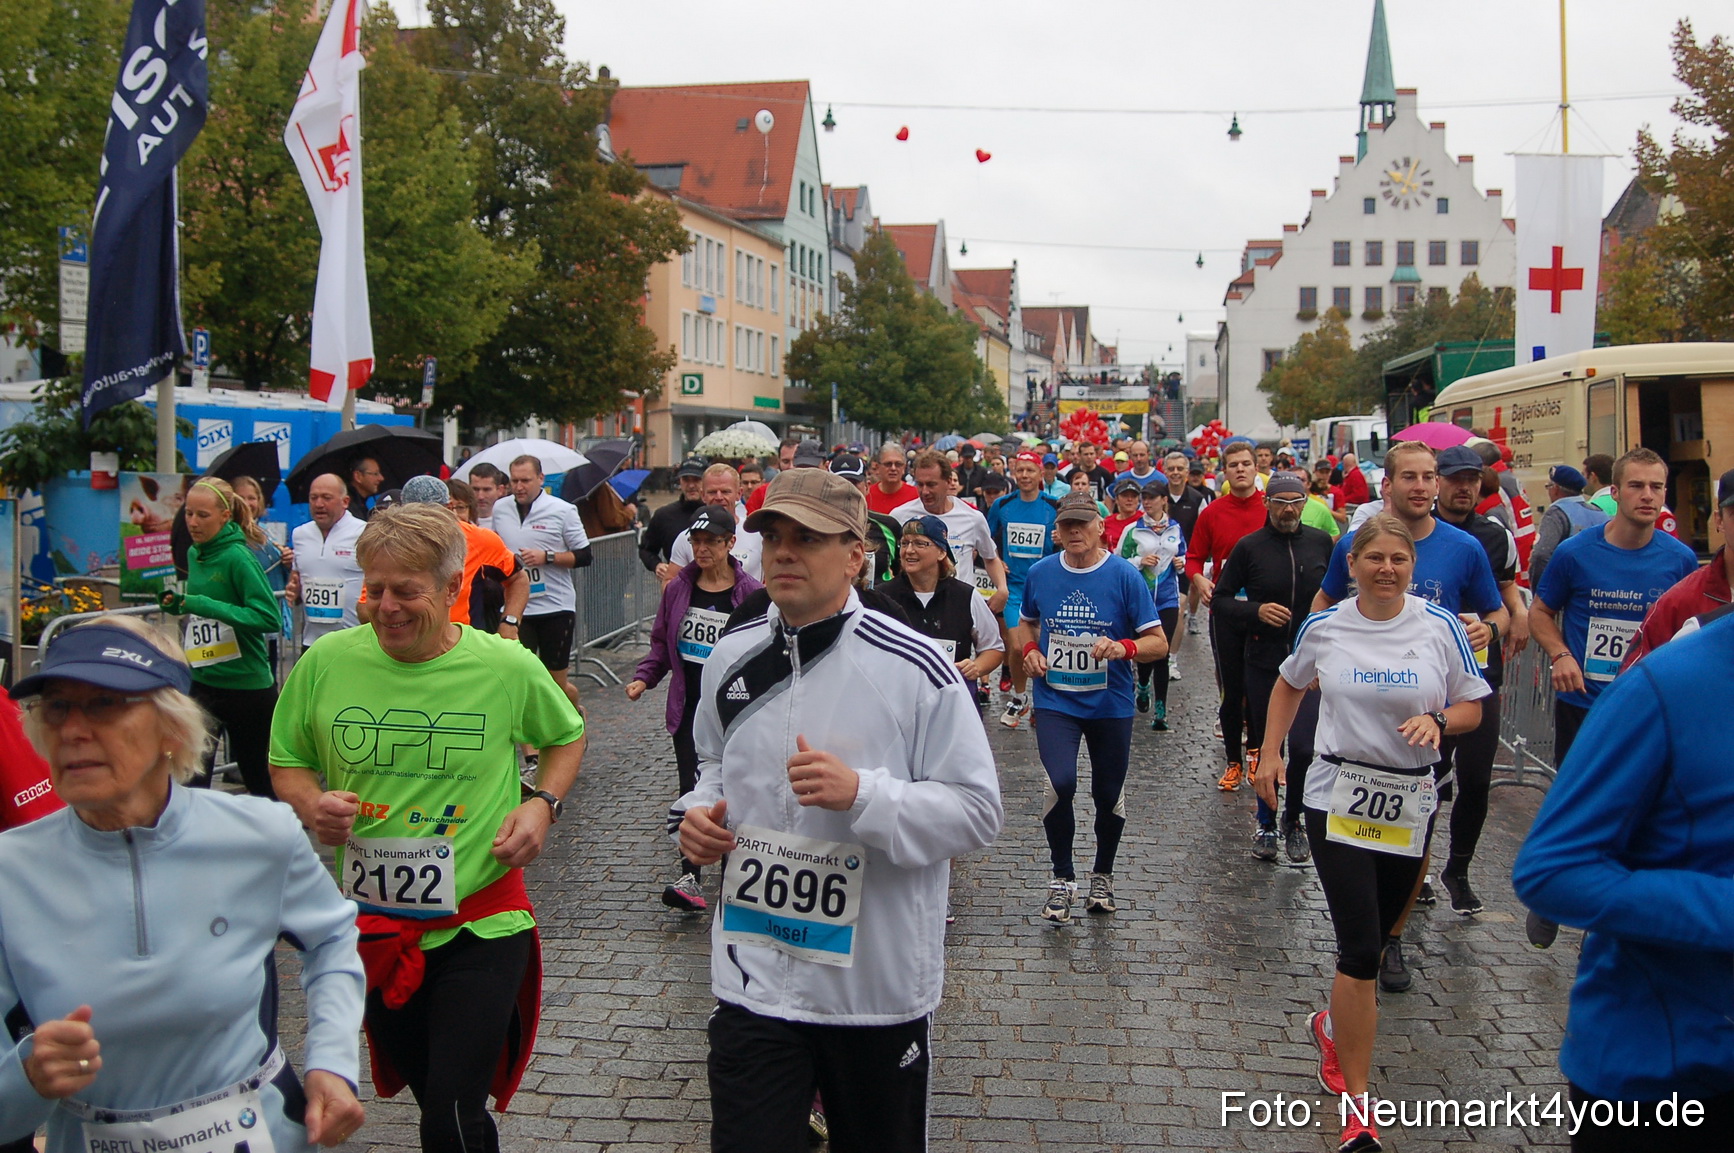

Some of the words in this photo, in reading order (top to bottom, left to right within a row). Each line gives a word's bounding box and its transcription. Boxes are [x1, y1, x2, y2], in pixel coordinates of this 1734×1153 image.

[197, 335, 206, 362] P
[684, 376, 700, 392] D
[1011, 531, 1041, 546] 2647
[305, 588, 338, 606] 2591
[1591, 588, 1643, 600] Kirwaläufer
[1588, 600, 1643, 611] Pettenhofen
[1088, 619, 1113, 627] Stadtlauf
[1590, 622, 1614, 632] PARTL
[1615, 626, 1636, 634] Neum
[192, 622, 221, 646] 501
[1050, 638, 1066, 647] PARTL
[102, 648, 153, 667] 2XU
[202, 649, 215, 658] Eva
[1354, 668, 1418, 684] heinloth
[726, 690, 750, 700] adidas
[332, 706, 486, 770] OPF
[375, 769, 456, 780] Automatisierungstechnik
[1340, 770, 1368, 784] PARTL
[1370, 778, 1409, 791] Neumarkt
[14, 779, 52, 807] BOCK
[1347, 787, 1404, 821] 203
[409, 811, 468, 824] Bretschneider
[1355, 825, 1381, 839] Jutta
[346, 839, 371, 859] PARTL
[374, 848, 431, 859] Neumarkt
[735, 836, 773, 856] PARTL
[777, 845, 839, 866] Neumarkt
[351, 860, 442, 904] 2122
[735, 858, 847, 918] 2696
[765, 920, 809, 943] Josef
[143, 1119, 232, 1153] Neumarkt
